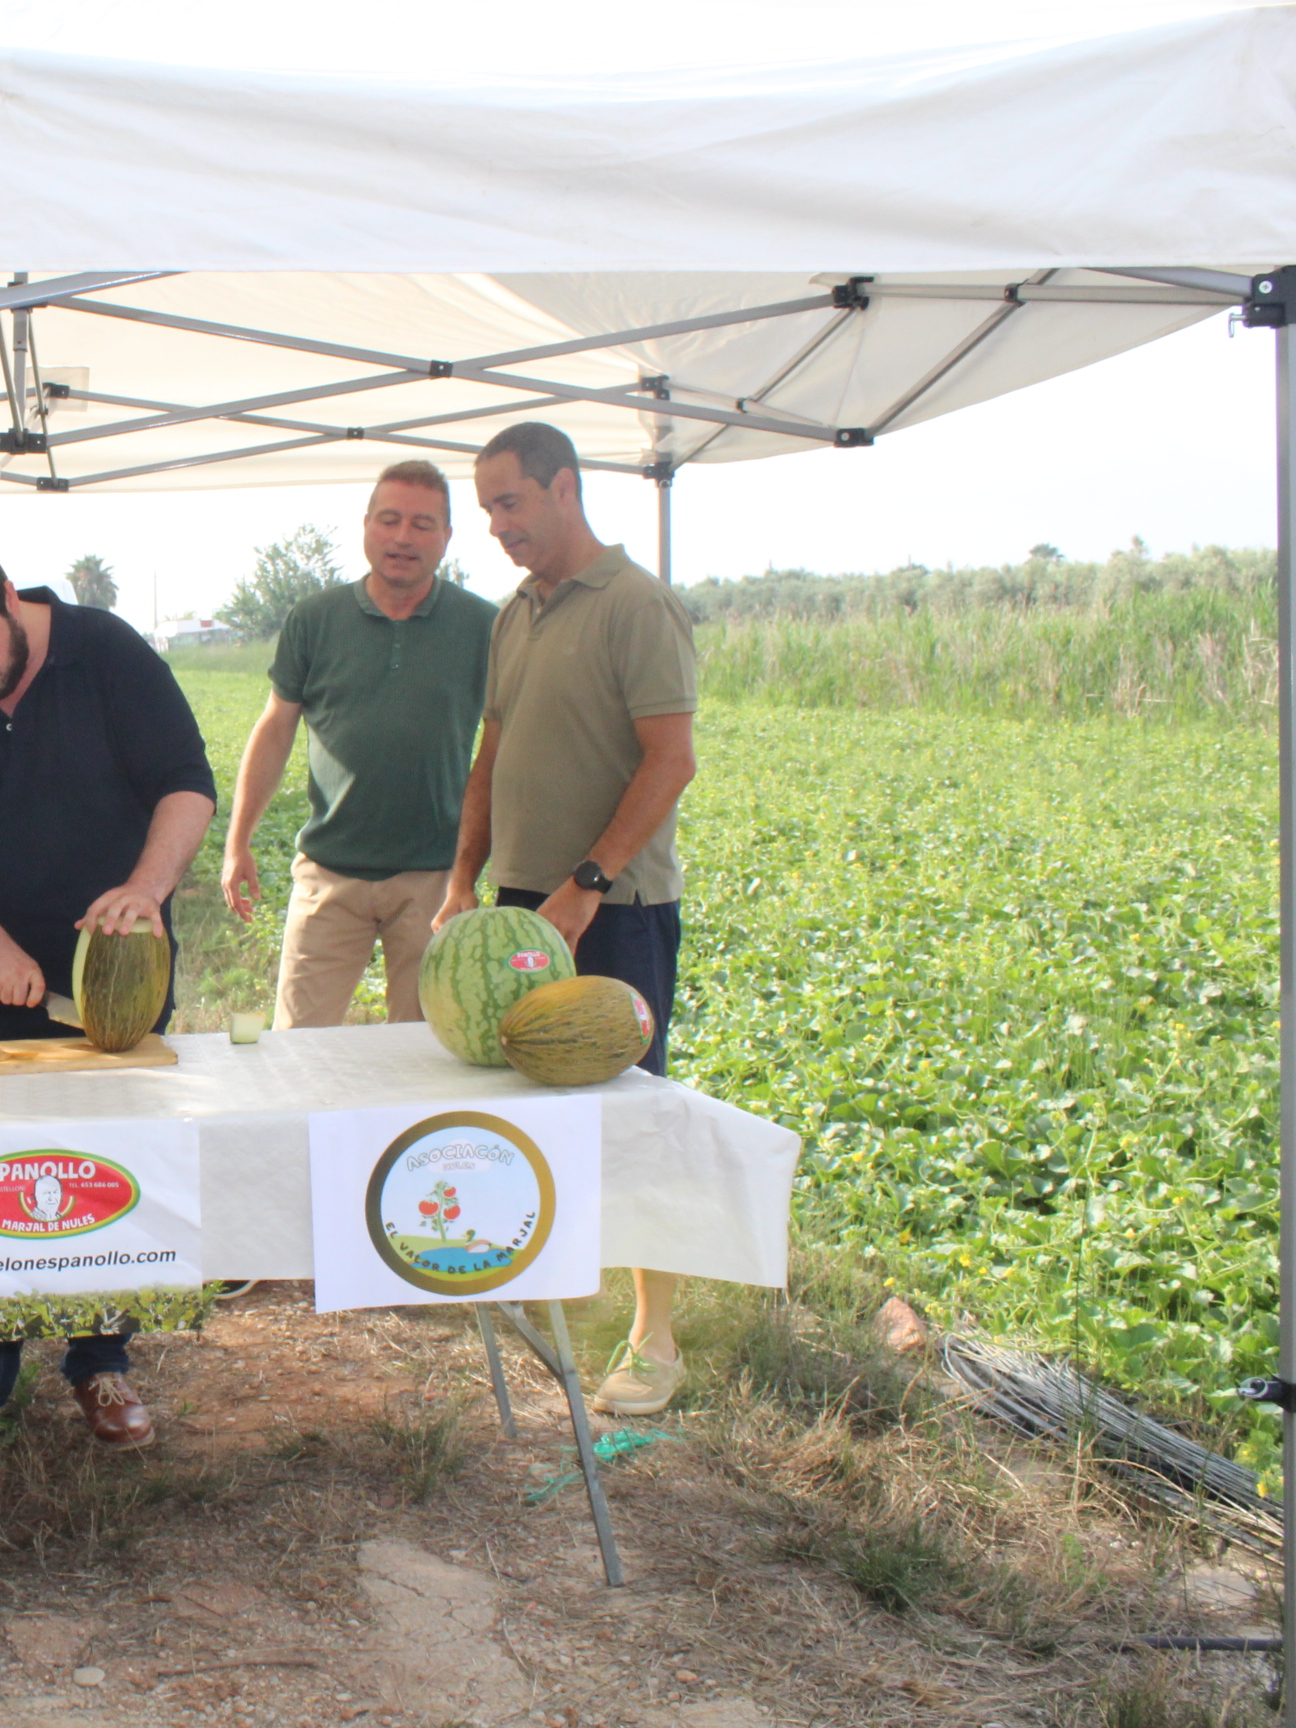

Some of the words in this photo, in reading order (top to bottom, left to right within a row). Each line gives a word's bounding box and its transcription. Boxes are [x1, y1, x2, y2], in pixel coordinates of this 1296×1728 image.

[406, 1144, 514, 1171] ASOCIACÓN
[1, 1219, 45, 1232] MARJAL
[48, 1222, 59, 1231] DE
[62, 1213, 95, 1231] NULES
[385, 1222, 399, 1239] EL
[399, 1241, 440, 1271] VALOR
[447, 1265, 467, 1274] DE
[473, 1260, 491, 1271] LA
[496, 1211, 535, 1262] MARJAL
